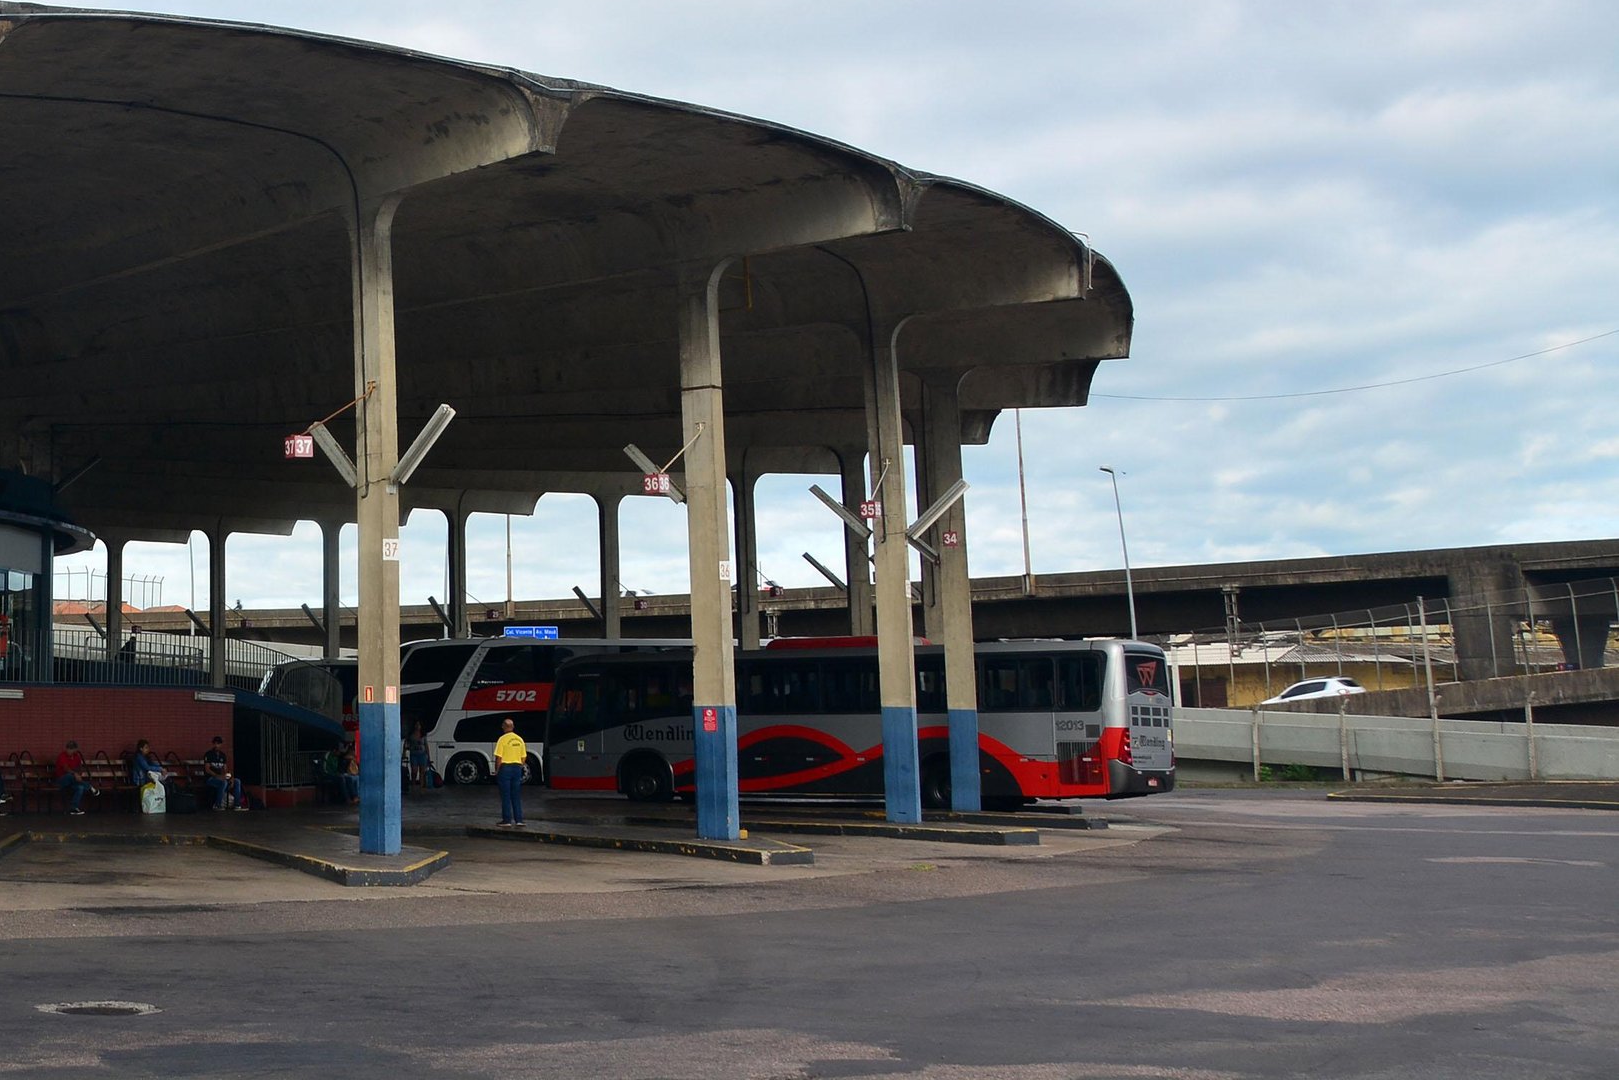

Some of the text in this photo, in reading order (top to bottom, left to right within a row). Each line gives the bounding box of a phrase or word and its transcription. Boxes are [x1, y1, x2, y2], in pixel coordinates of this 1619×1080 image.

[285, 440, 295, 455] 37
[296, 439, 312, 454] 37
[644, 477, 658, 491] 36
[659, 477, 669, 491] 36
[860, 504, 875, 516] 35
[943, 533, 957, 544] 34
[384, 542, 398, 557] 37
[720, 564, 730, 578] 36
[496, 690, 537, 702] 5702
[1055, 720, 1085, 731] 12013
[624, 724, 694, 742] Wendlin
